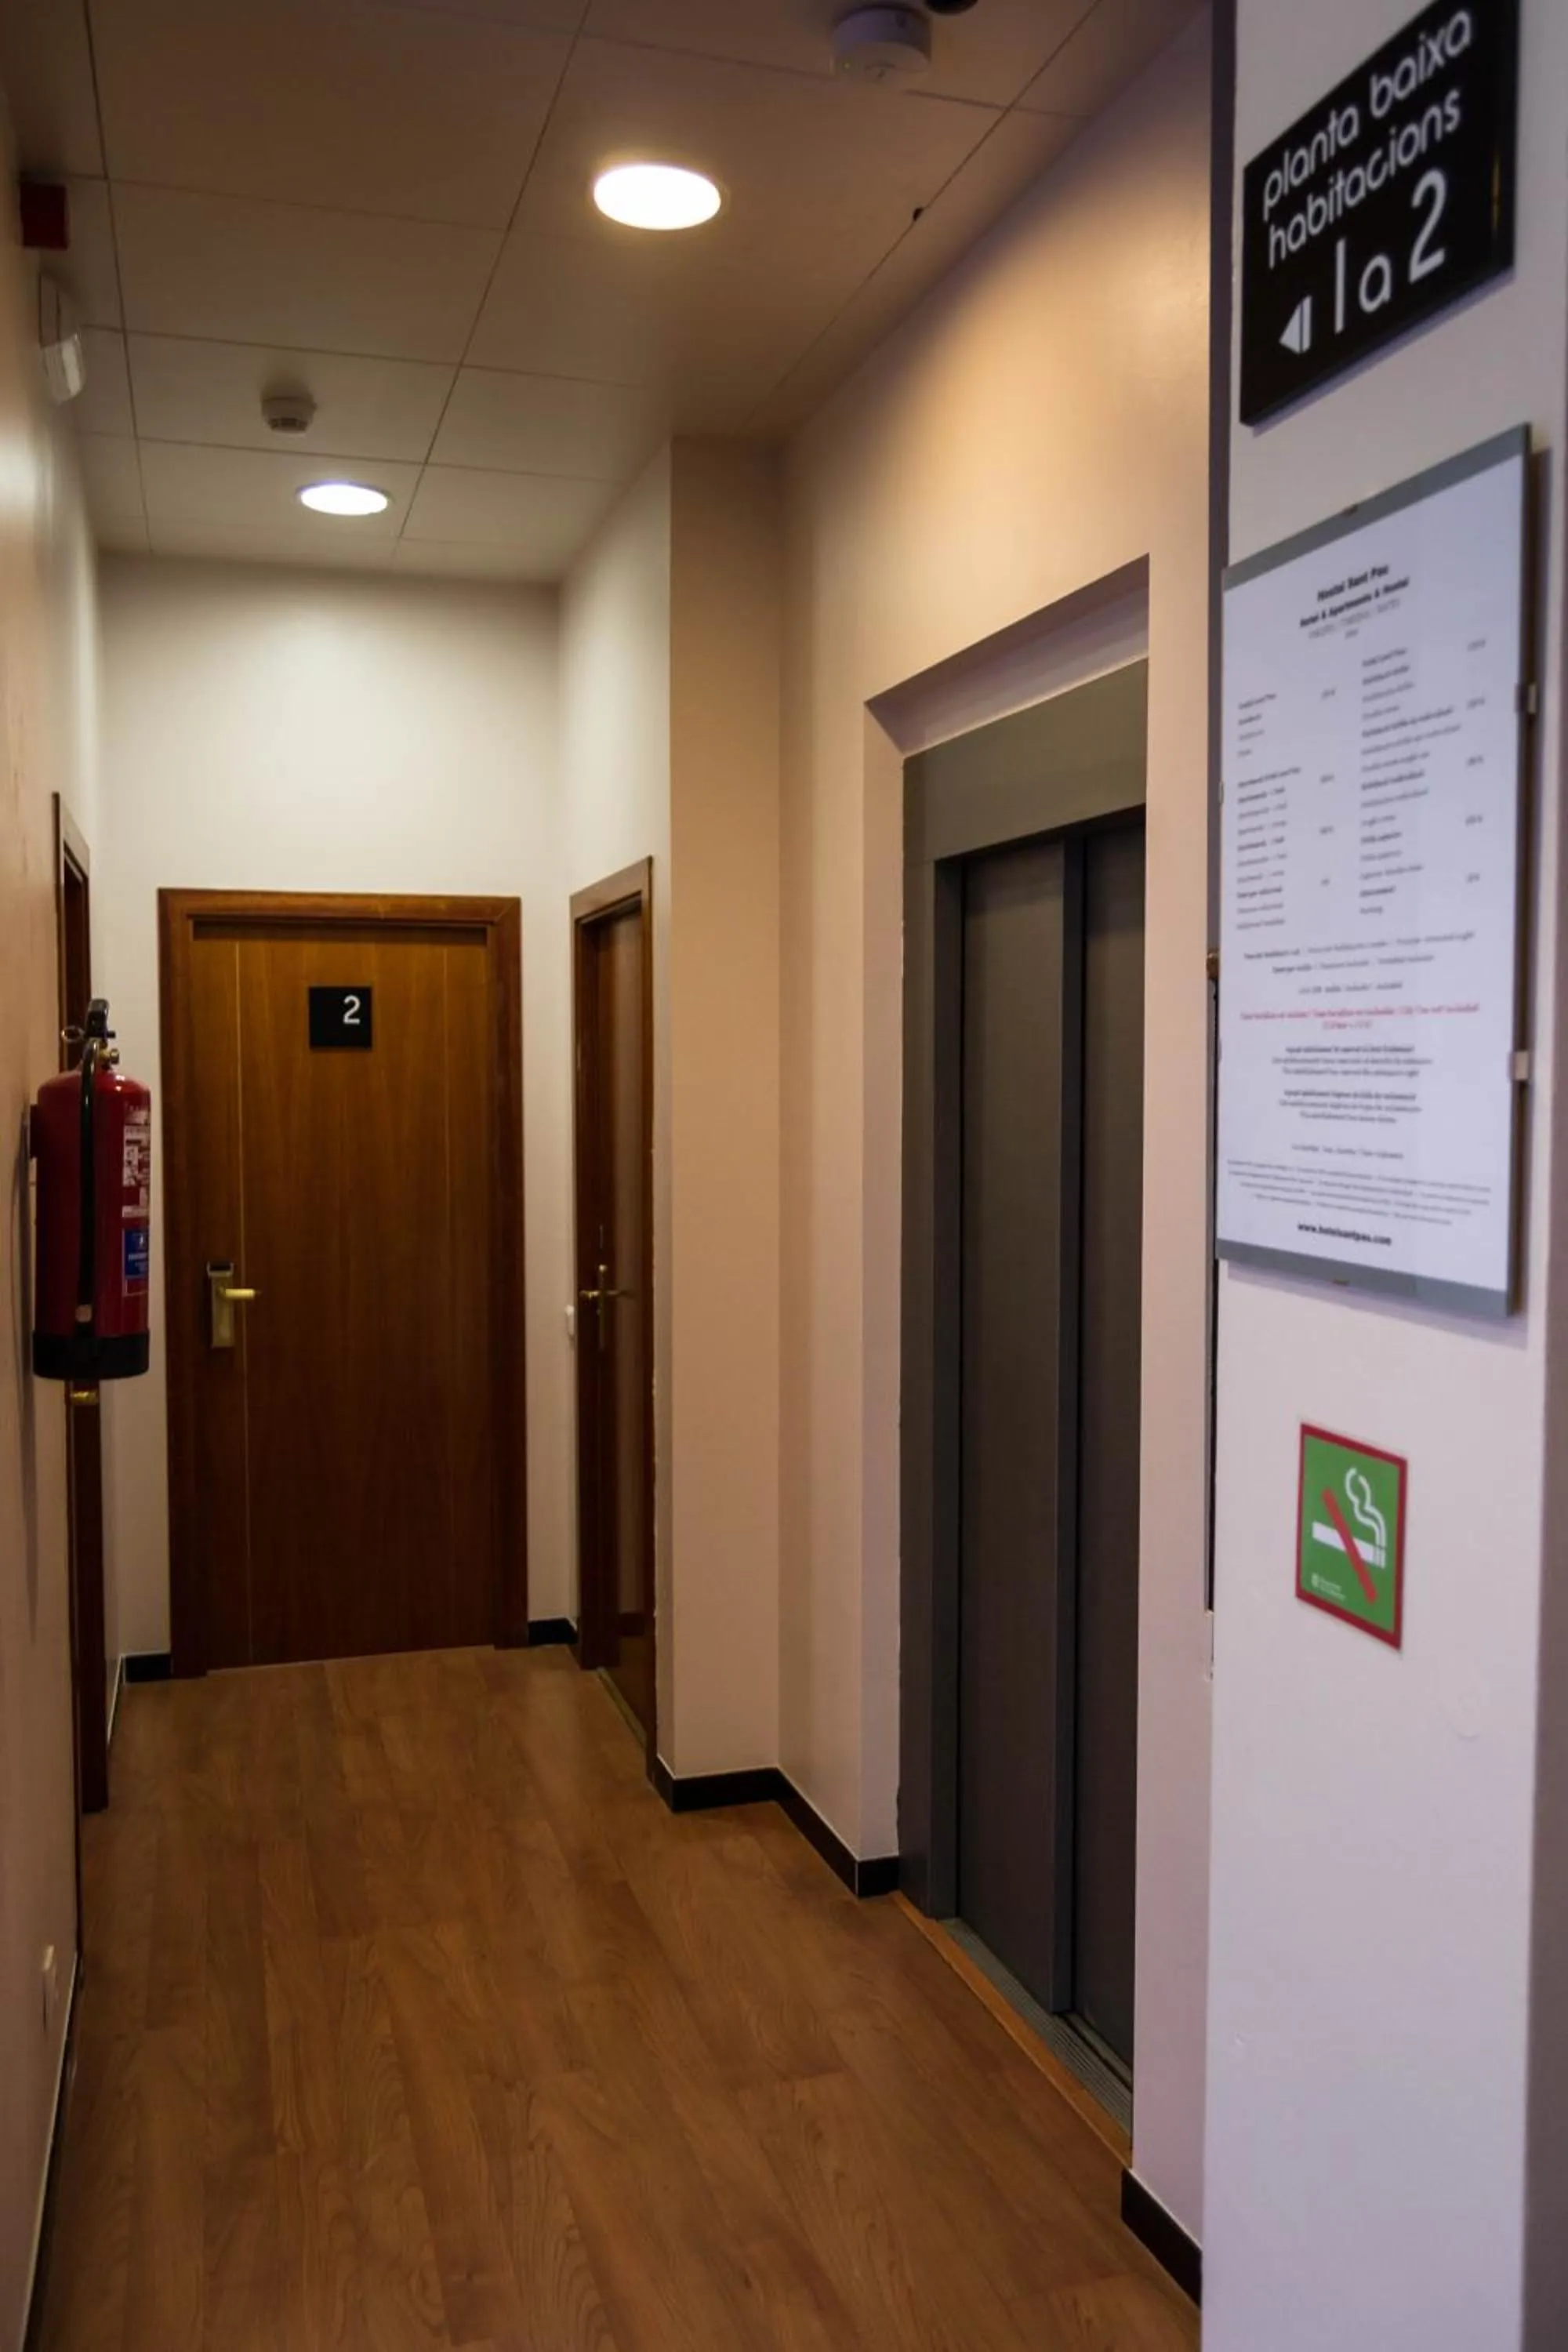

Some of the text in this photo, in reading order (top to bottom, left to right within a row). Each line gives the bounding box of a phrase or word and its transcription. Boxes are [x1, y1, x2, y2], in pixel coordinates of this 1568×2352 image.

[1263, 10, 1472, 222] planta baixa
[1269, 89, 1461, 269] habitacions
[1408, 169, 1446, 283] 2
[343, 994, 361, 1025] 2
